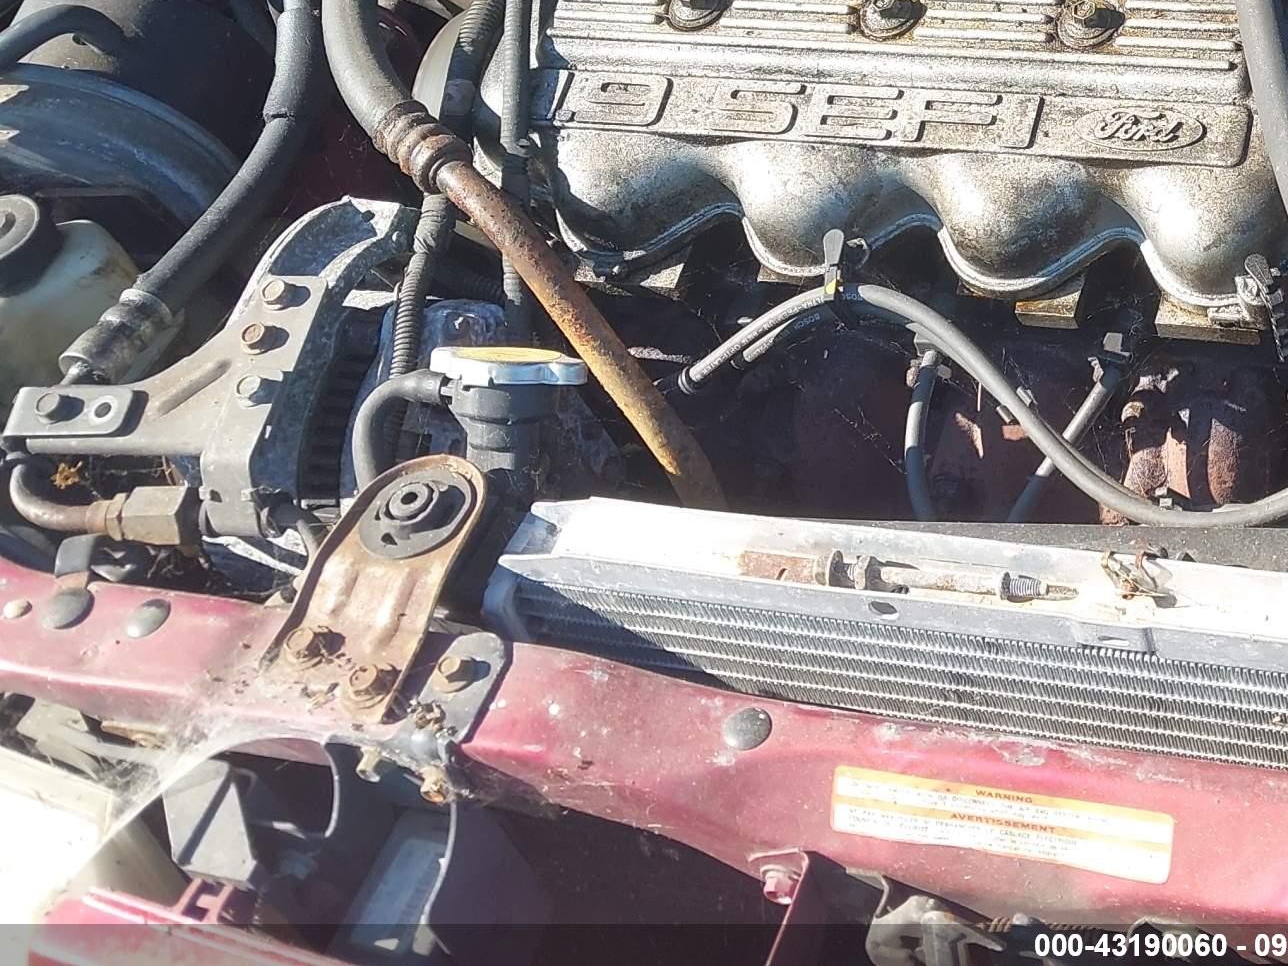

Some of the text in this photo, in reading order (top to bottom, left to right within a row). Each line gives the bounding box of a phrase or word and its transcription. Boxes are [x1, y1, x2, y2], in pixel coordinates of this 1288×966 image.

[700, 83, 1045, 150] SEFI
[1093, 110, 1185, 143] Ford
[976, 789, 1033, 804] WARNING
[950, 812, 1056, 834] AVERTISSEMENT
